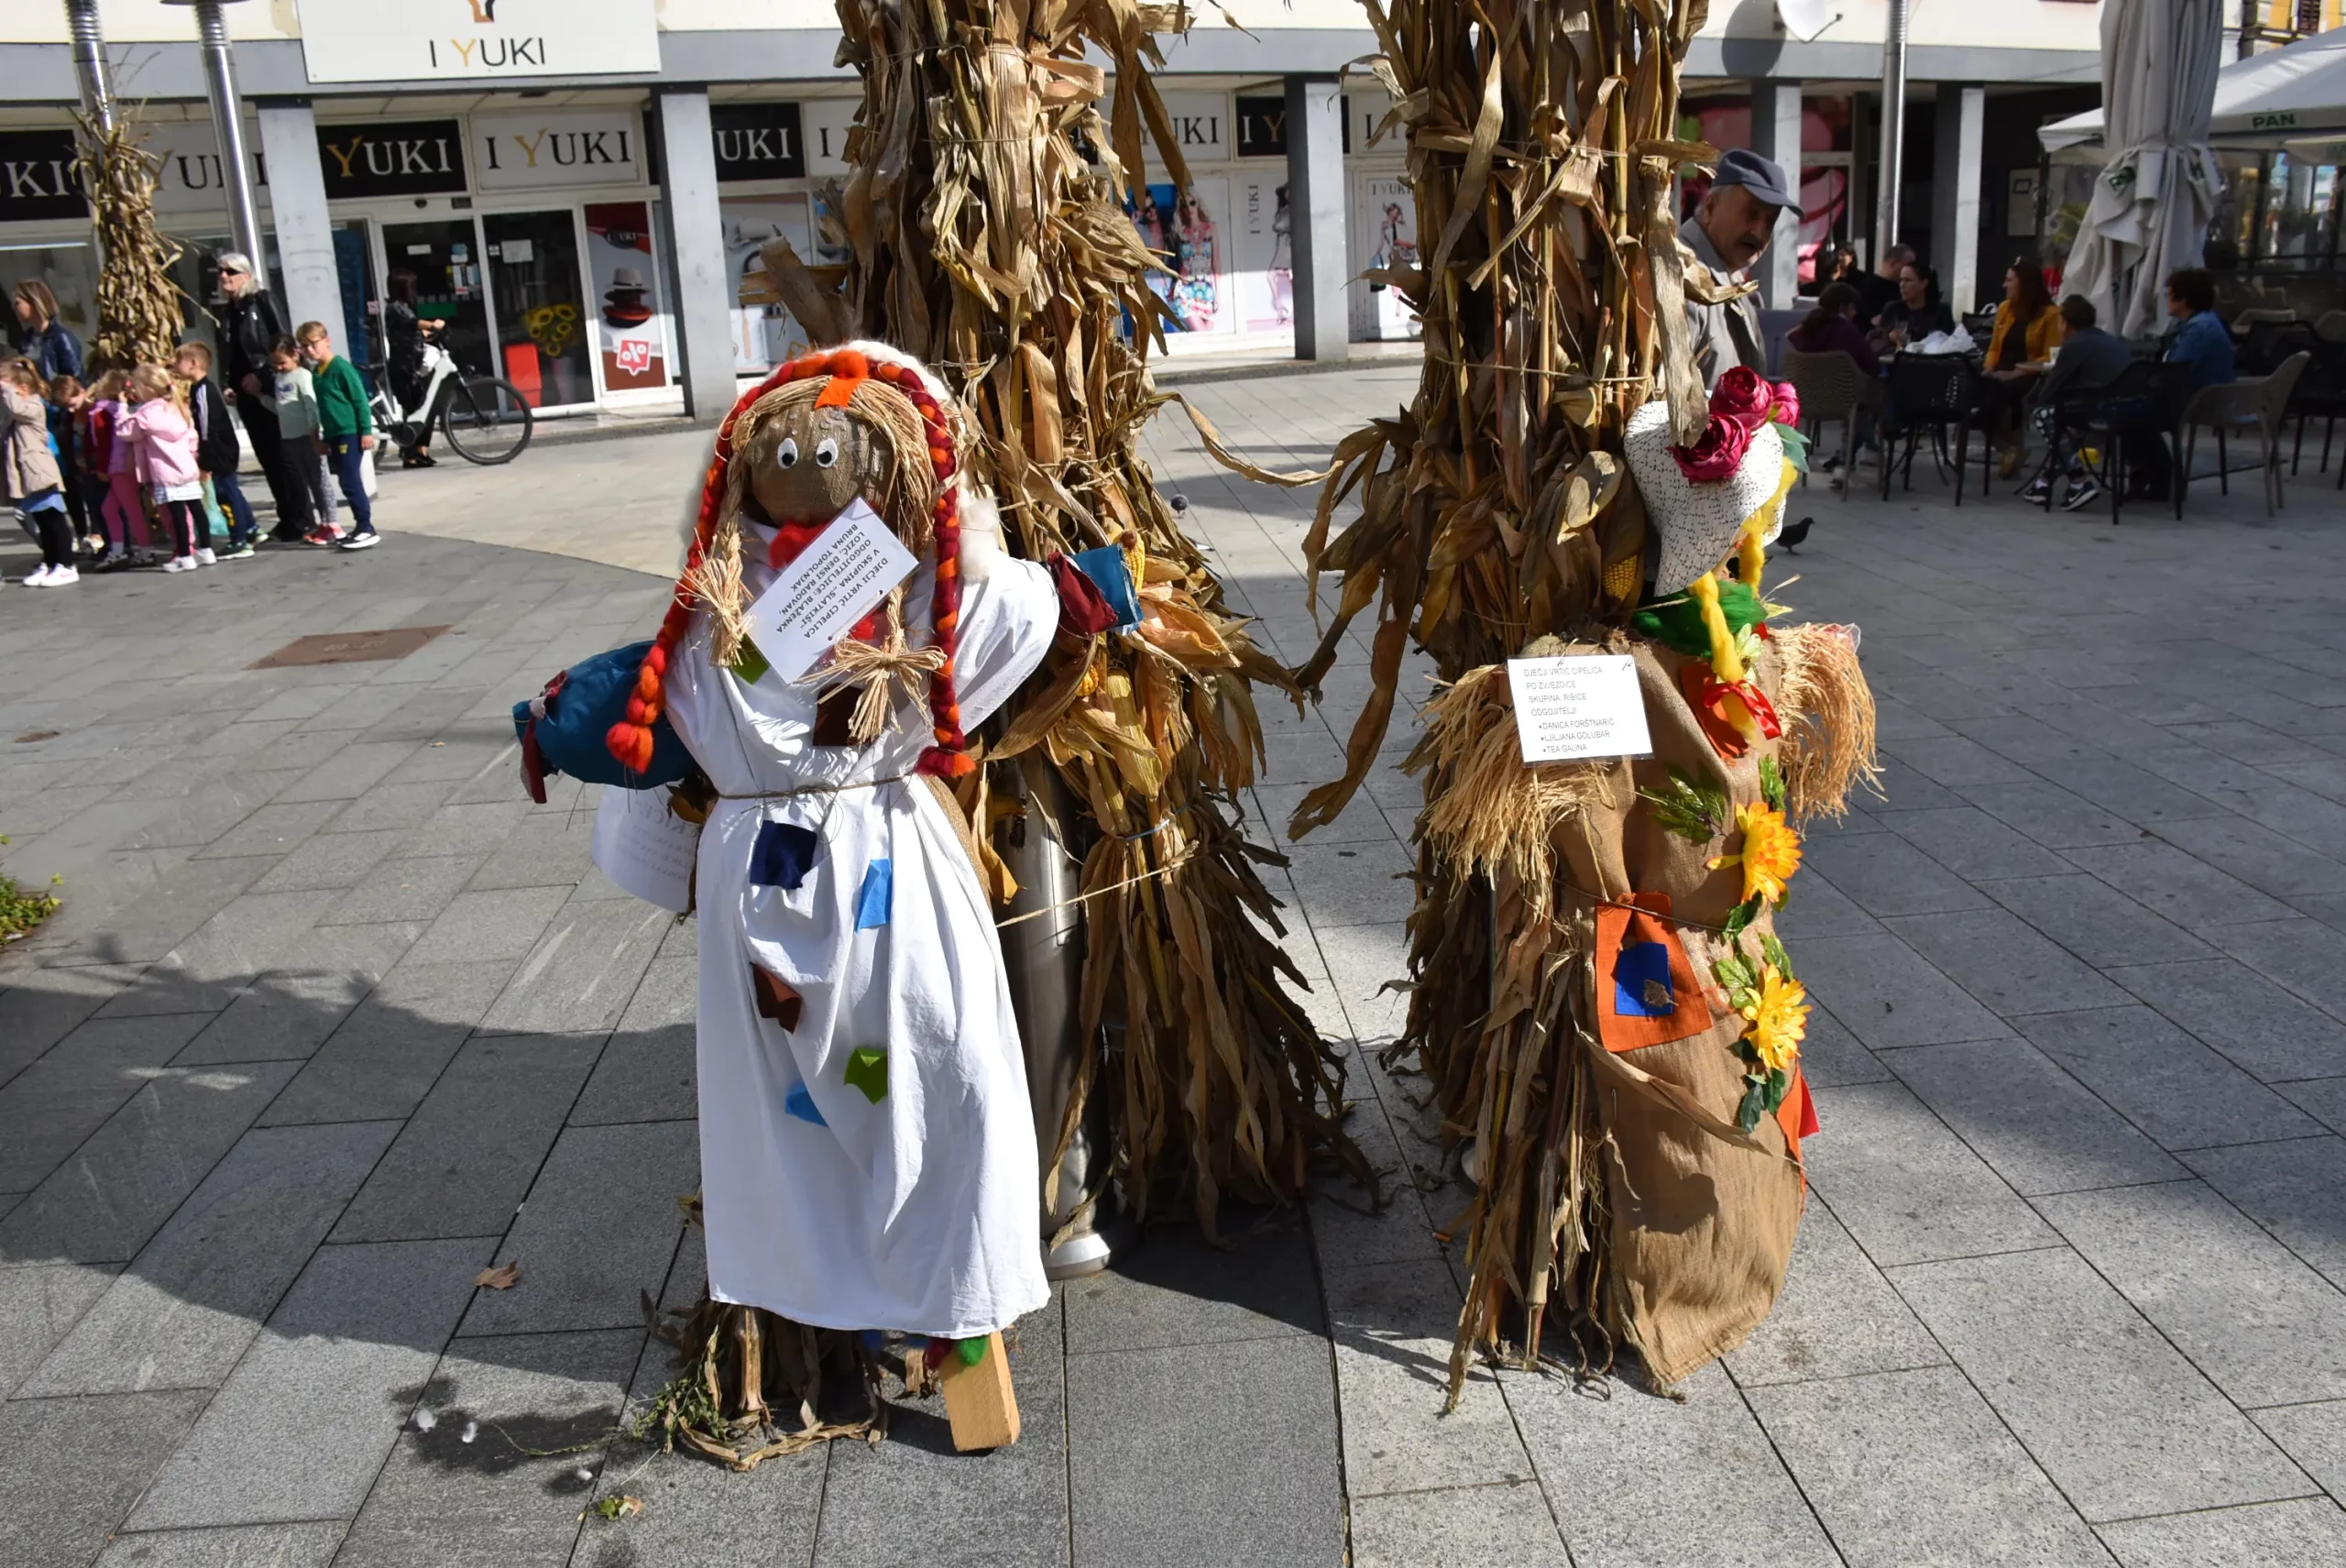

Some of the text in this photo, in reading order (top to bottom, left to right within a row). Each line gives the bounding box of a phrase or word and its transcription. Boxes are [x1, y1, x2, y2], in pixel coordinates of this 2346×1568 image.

[429, 37, 546, 68] I YUKI
[2253, 113, 2296, 128] PAN
[326, 135, 453, 178] YUKI
[485, 127, 633, 170] I YUKI
[713, 126, 793, 162] UKI
[0, 159, 71, 198] KI
[789, 522, 859, 592] BRUNA TOPOLNJAK
[815, 554, 840, 580] DENSI
[838, 553, 873, 587] SKUPINA
[774, 538, 872, 633] ODGOJITELJICE: BLAŽENKA
[777, 577, 817, 616] RADOVAN,
[803, 556, 889, 639] DJEČJI VRTIĆ CIPELICA
[1538, 680, 1577, 690] ZVJEZDICE
[1572, 666, 1604, 675] CIPELICA
[1531, 706, 1577, 716] ODGOJITELJI
[1563, 692, 1587, 701] RIBICE
[1542, 720, 1570, 730] DANICA
[1576, 729, 1611, 740] GOLUBAR
[1546, 743, 1587, 753] TEA GALINA
